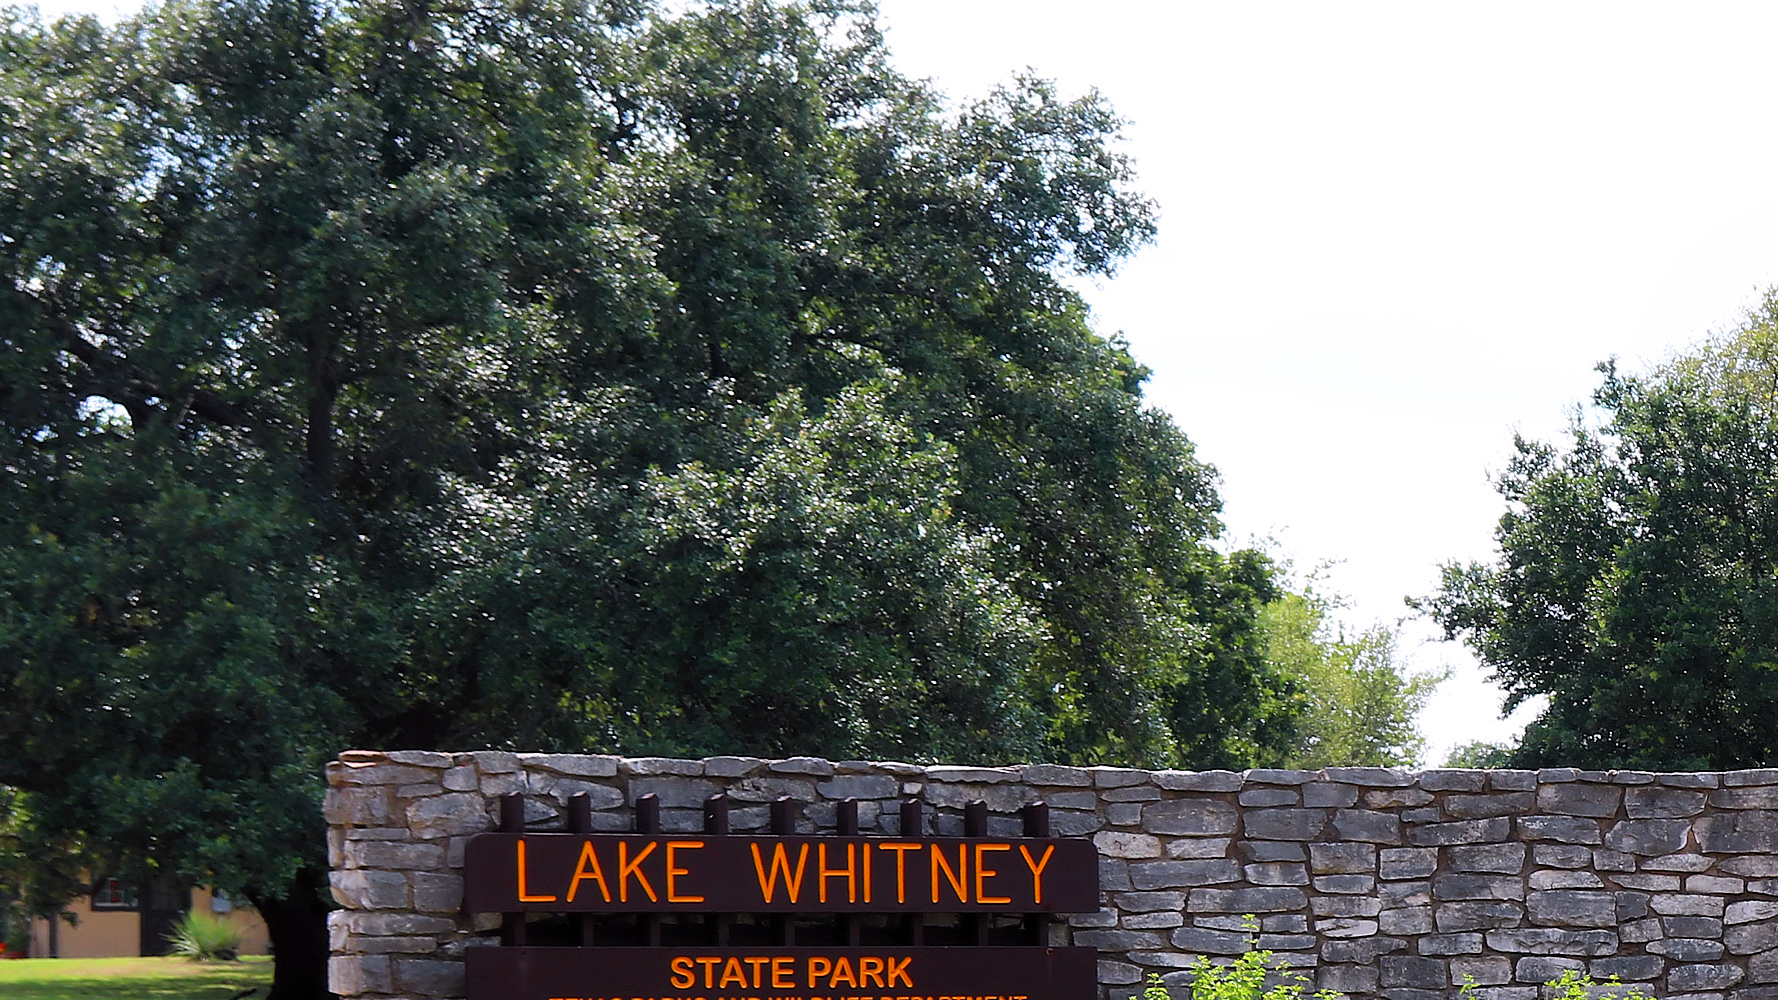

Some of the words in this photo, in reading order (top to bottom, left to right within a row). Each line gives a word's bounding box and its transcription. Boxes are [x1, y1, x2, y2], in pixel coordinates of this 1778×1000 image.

[518, 839, 704, 903] LAKE
[751, 842, 1055, 904] WHITNEY
[670, 956, 796, 989] STATE
[808, 956, 914, 989] PARK
